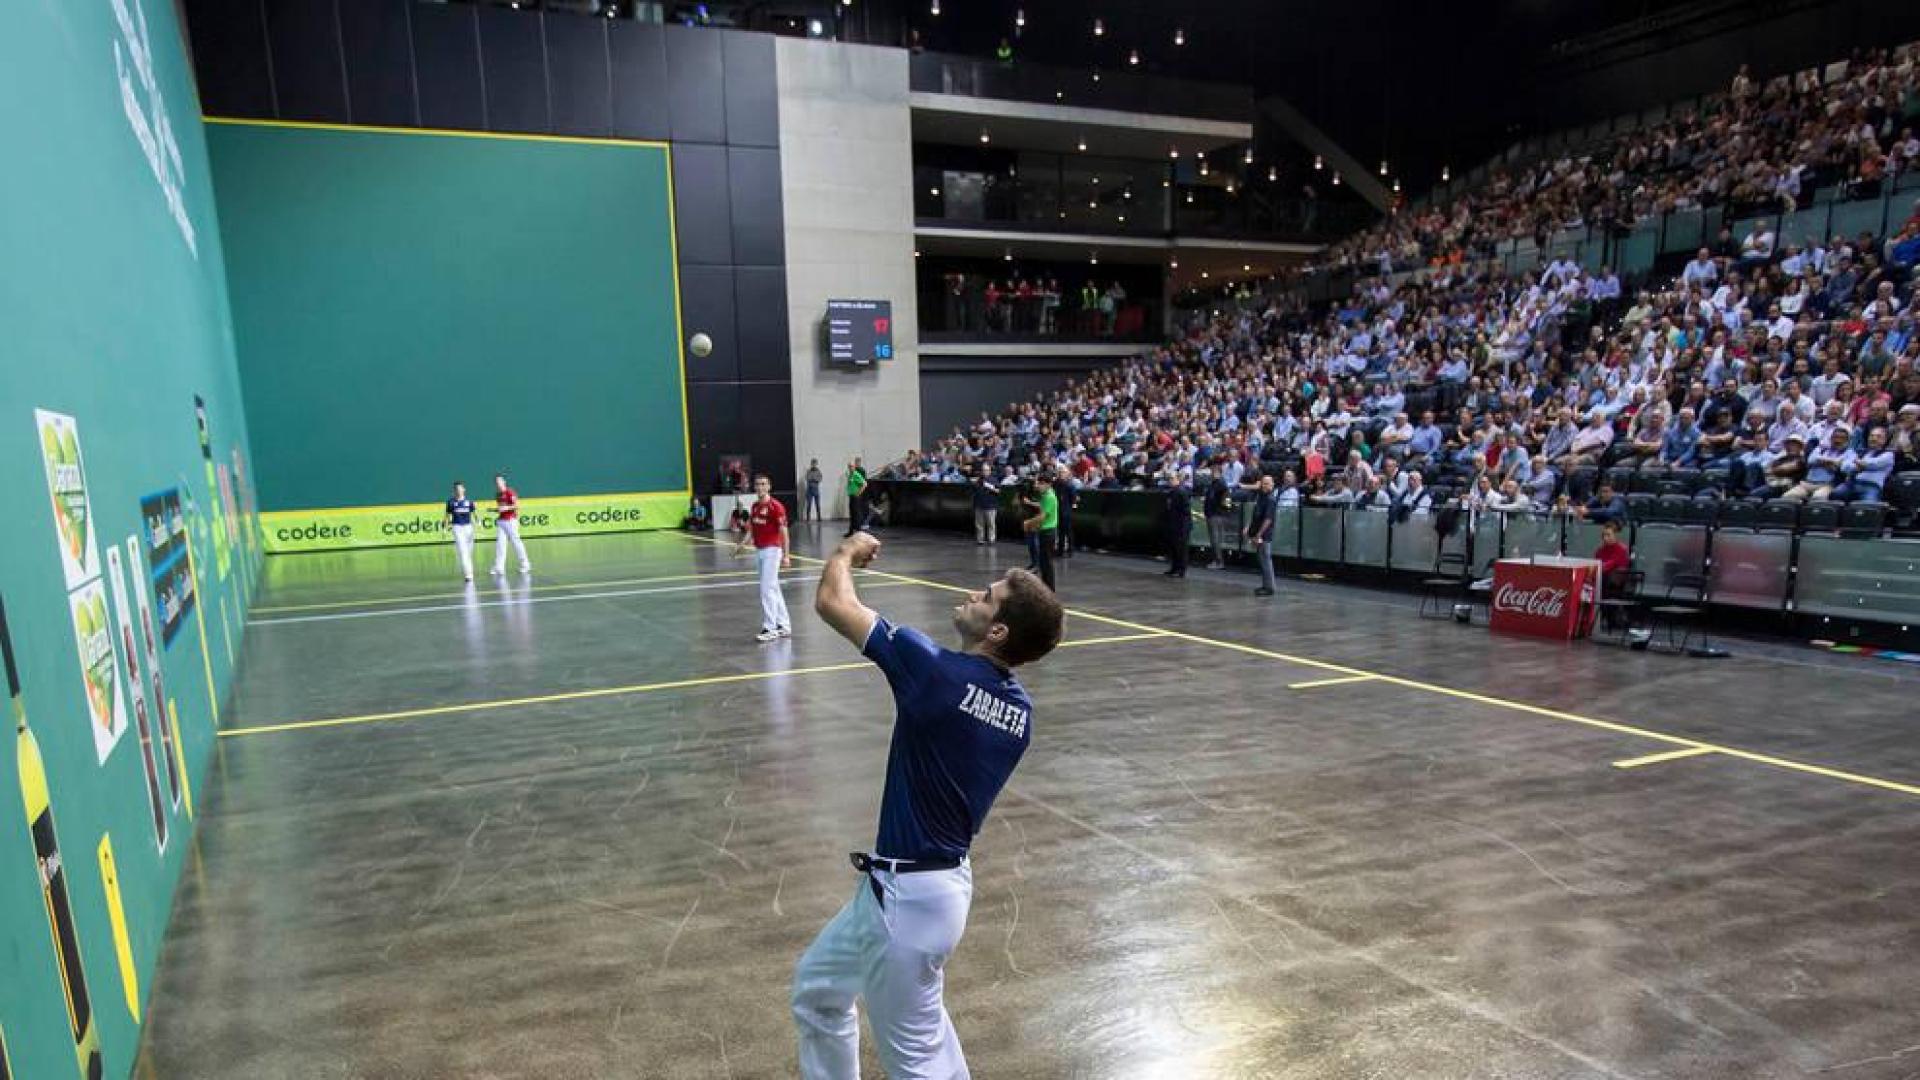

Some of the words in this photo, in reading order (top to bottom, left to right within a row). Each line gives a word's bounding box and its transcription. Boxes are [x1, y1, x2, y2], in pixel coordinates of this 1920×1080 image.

[875, 343, 891, 358] 16
[277, 521, 352, 541] codere
[483, 513, 550, 529] cere
[575, 506, 641, 524] codere
[959, 682, 1027, 739] ZABALETA
